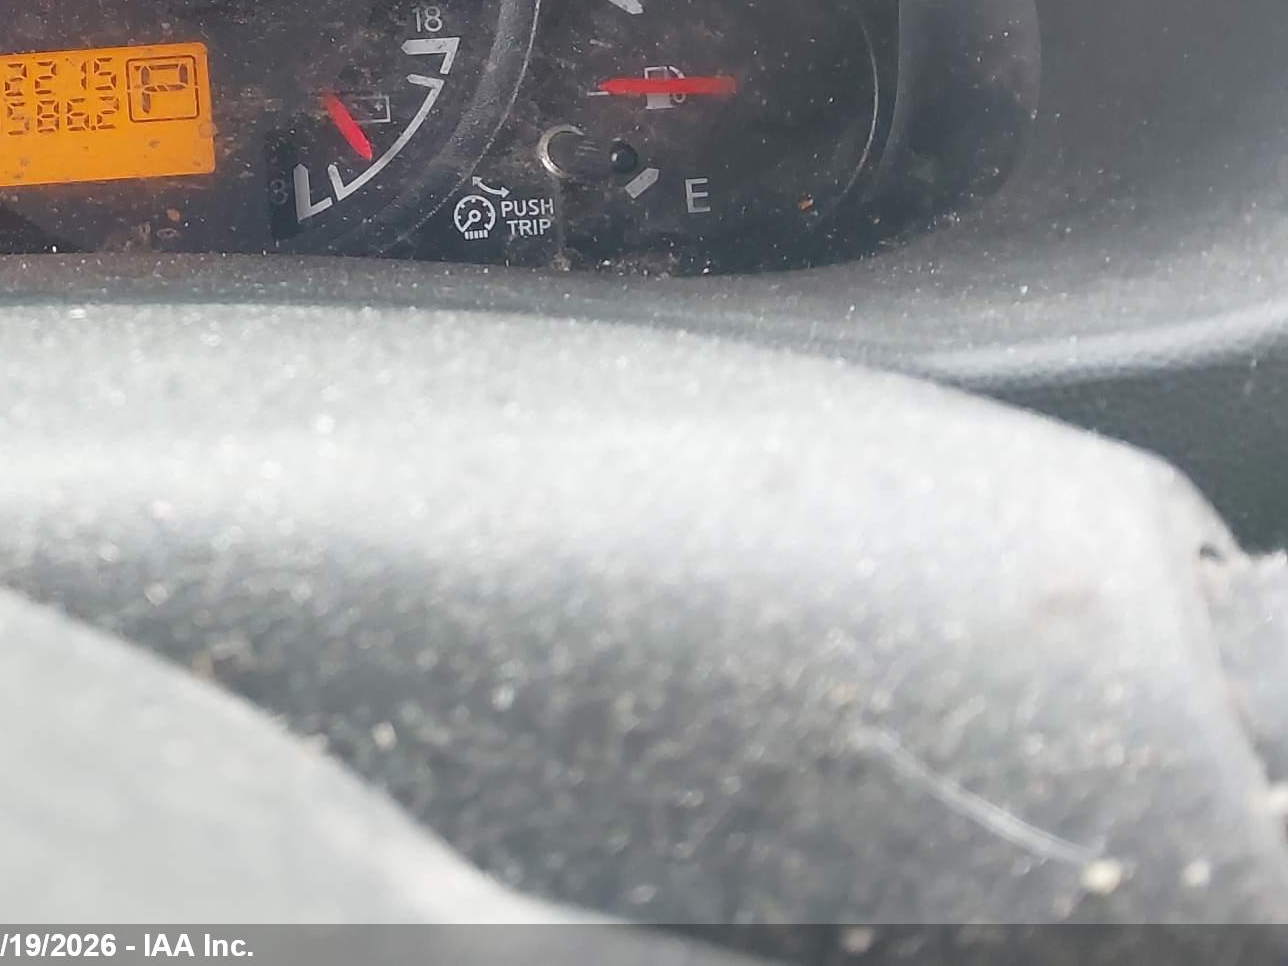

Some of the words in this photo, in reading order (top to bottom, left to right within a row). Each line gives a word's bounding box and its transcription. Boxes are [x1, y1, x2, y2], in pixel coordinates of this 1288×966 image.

[411, 5, 443, 32] 18
[684, 177, 710, 214] E
[500, 198, 554, 218] PUSH
[506, 219, 552, 236] TRIP
